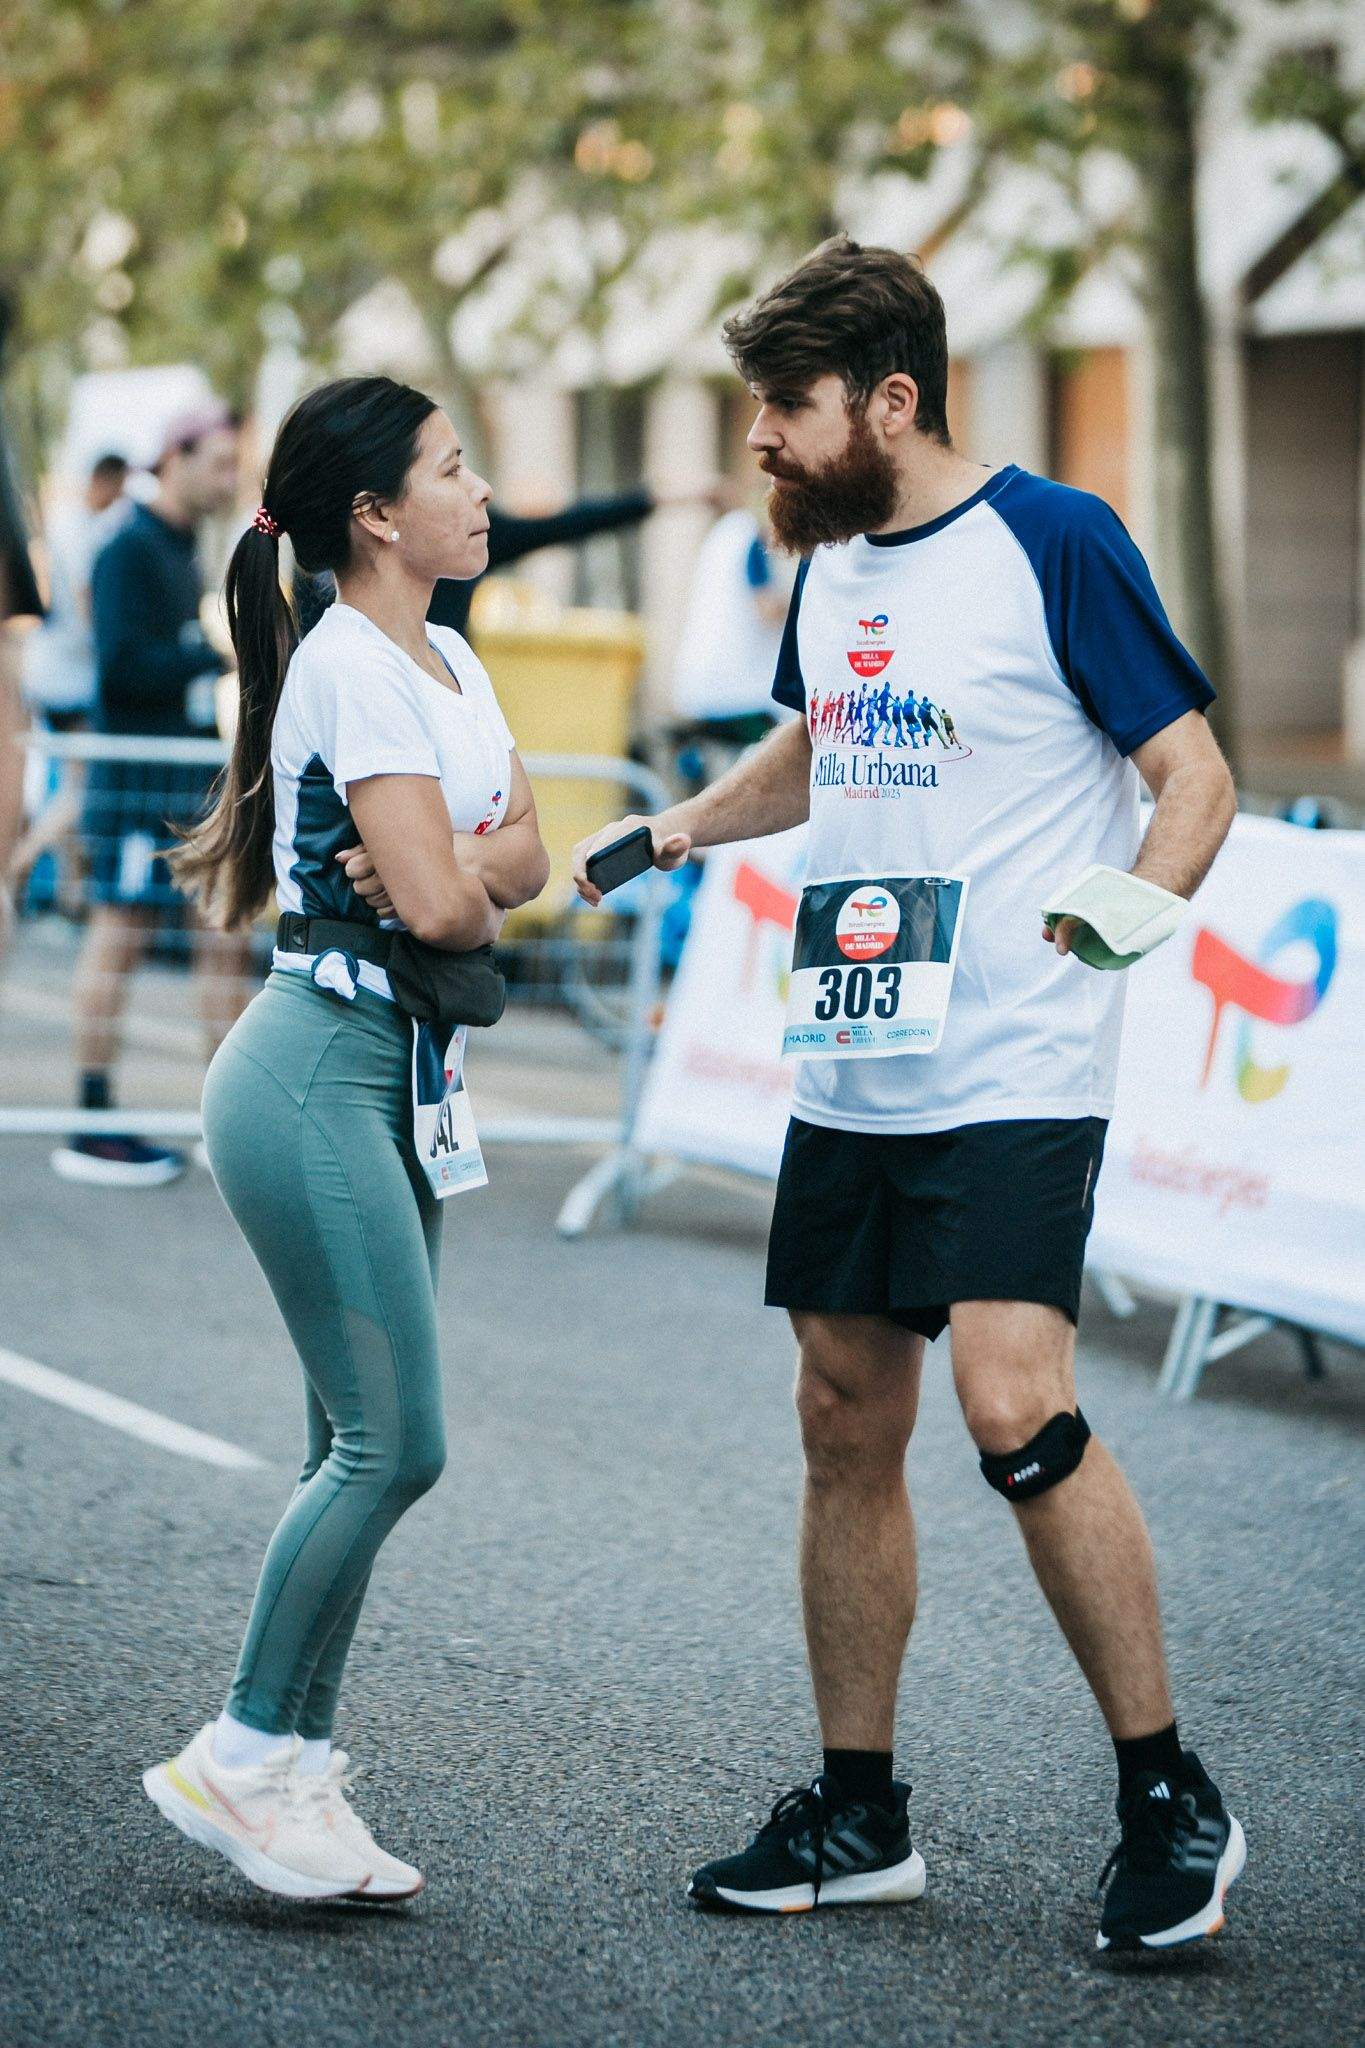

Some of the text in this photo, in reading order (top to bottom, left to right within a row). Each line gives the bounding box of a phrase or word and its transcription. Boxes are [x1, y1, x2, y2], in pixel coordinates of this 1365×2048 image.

[852, 752, 940, 787] Urbana
[843, 786, 879, 799] Madrid
[853, 934, 875, 942] MILLA
[815, 966, 902, 1021] 303
